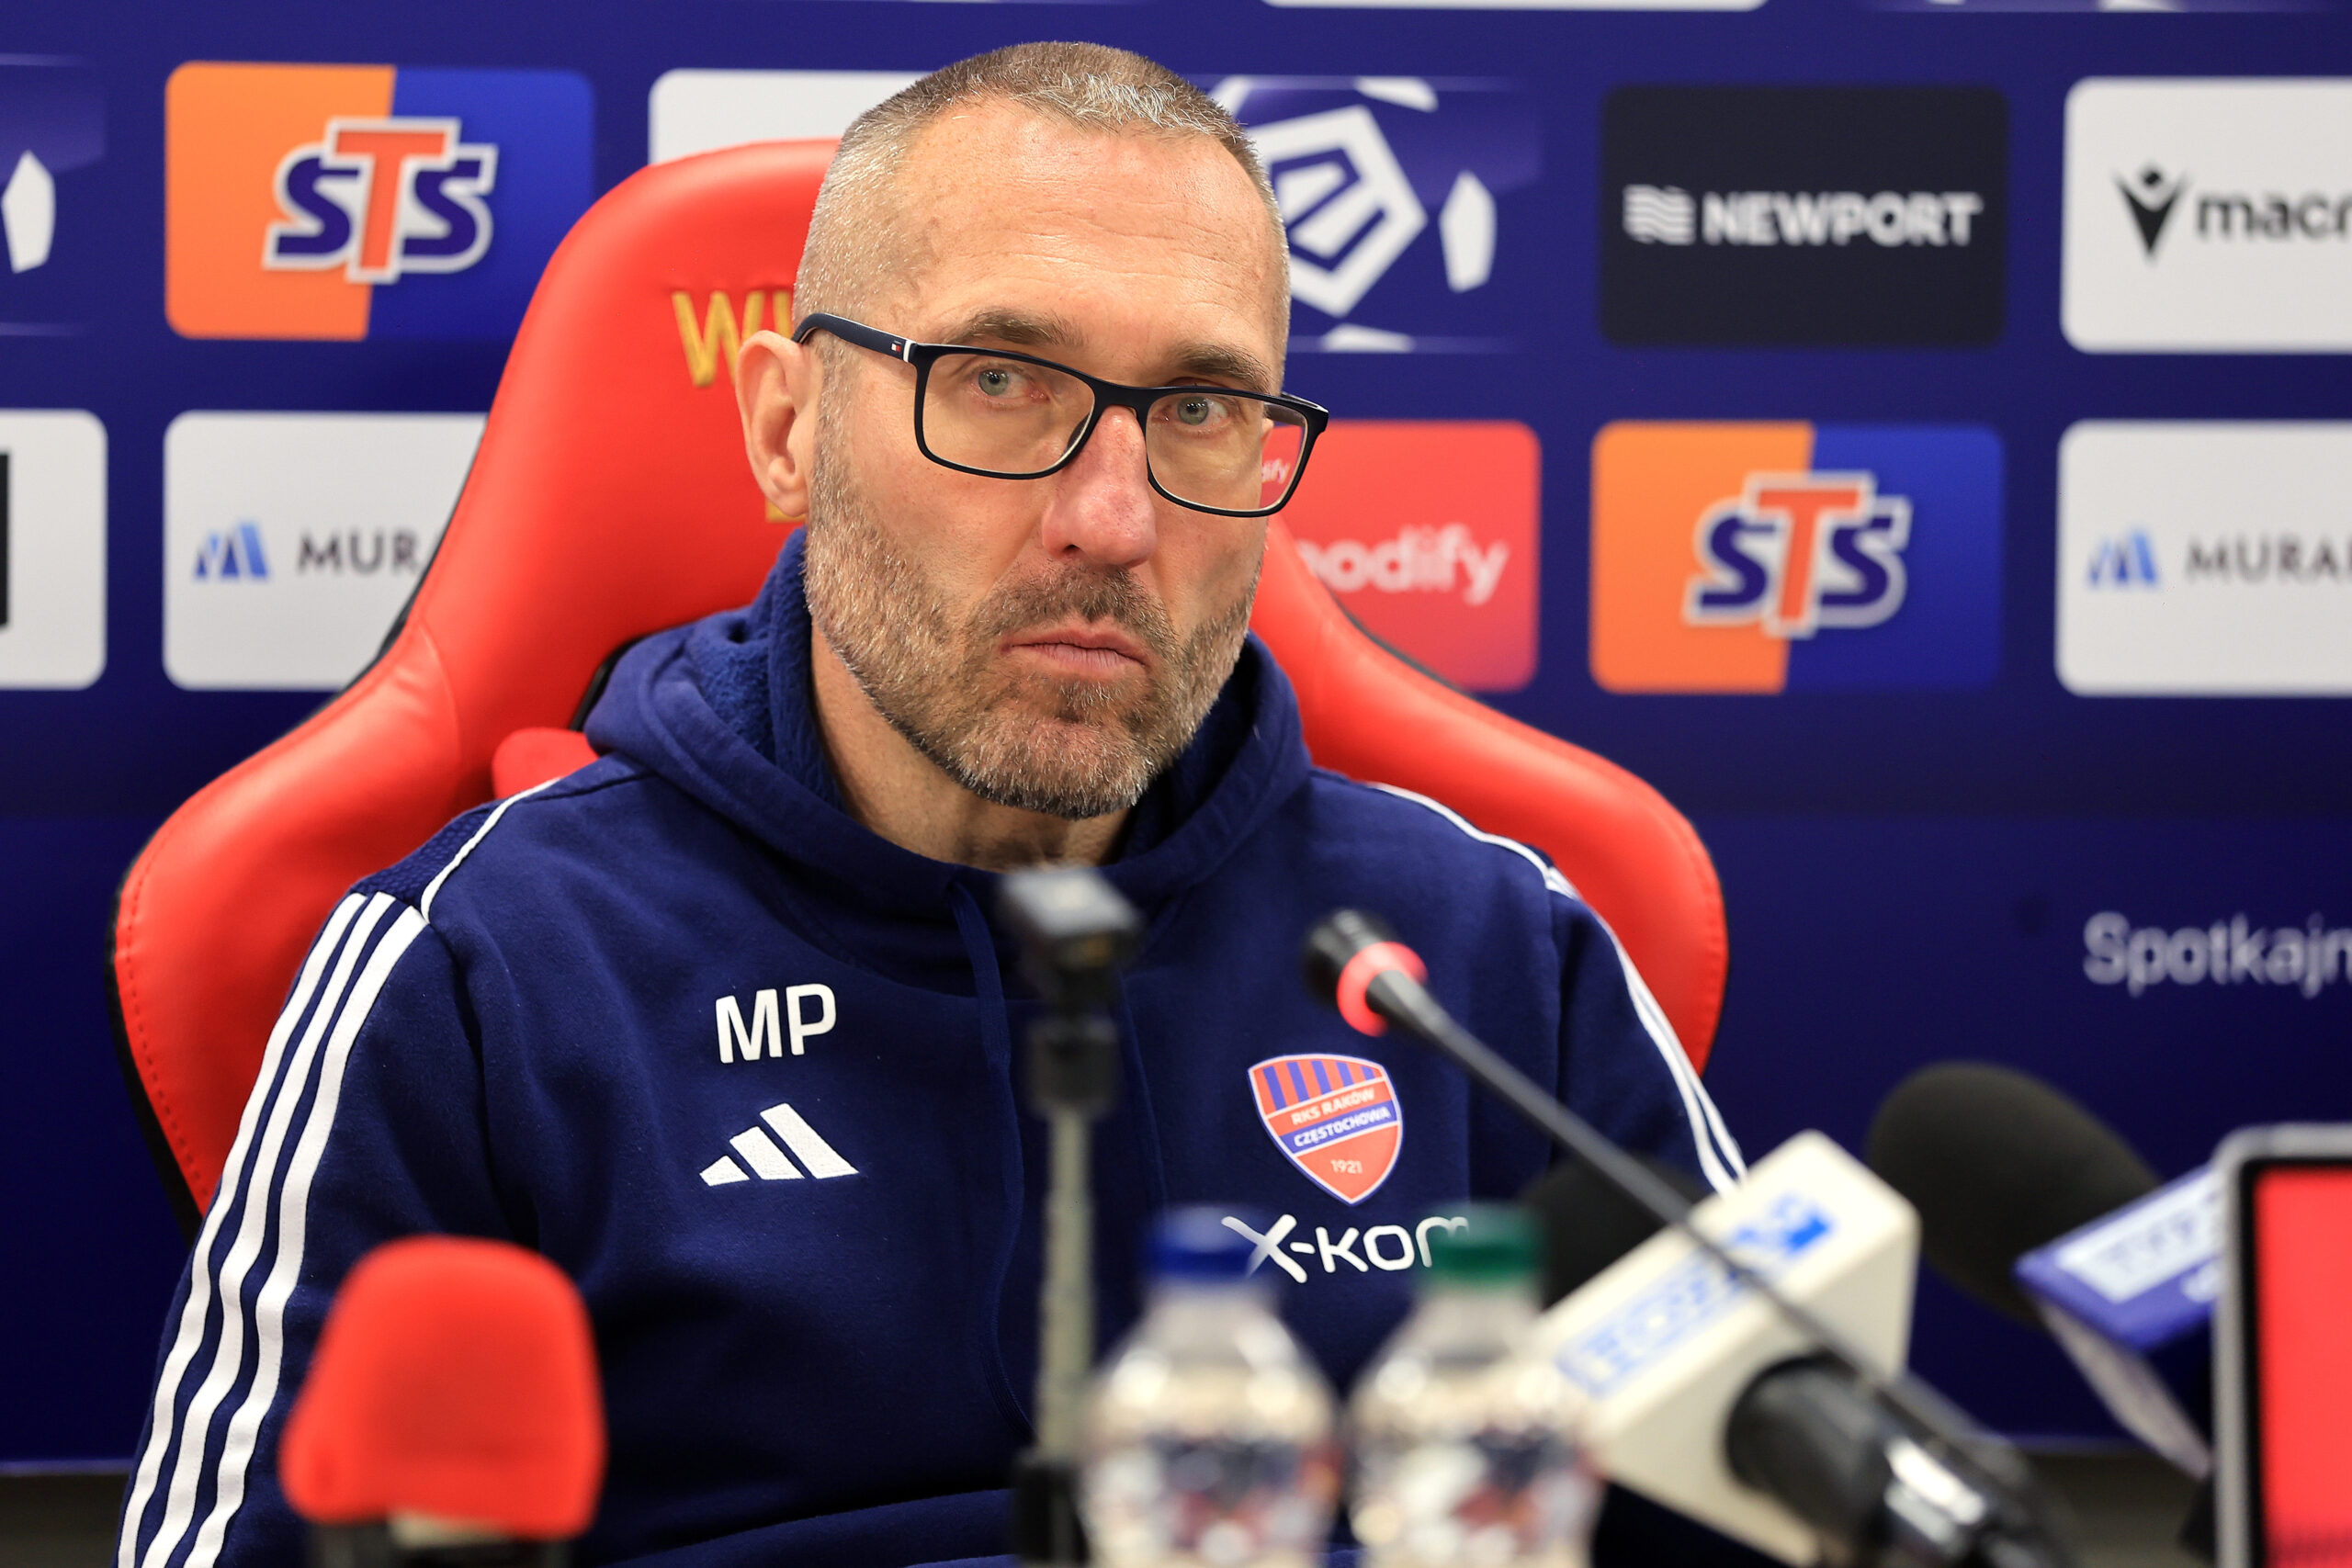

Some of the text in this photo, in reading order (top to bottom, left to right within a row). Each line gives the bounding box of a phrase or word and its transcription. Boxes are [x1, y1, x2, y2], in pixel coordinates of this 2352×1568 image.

[261, 116, 498, 285] STS
[1702, 190, 1984, 246] NEWPORT
[296, 529, 441, 577] MUR
[1679, 469, 1913, 640] STS
[2185, 533, 2352, 585] MURA
[716, 983, 837, 1065] MP
[1290, 1088, 1375, 1125] RKS RAKÓW
[1330, 1159, 1363, 1175] 1921
